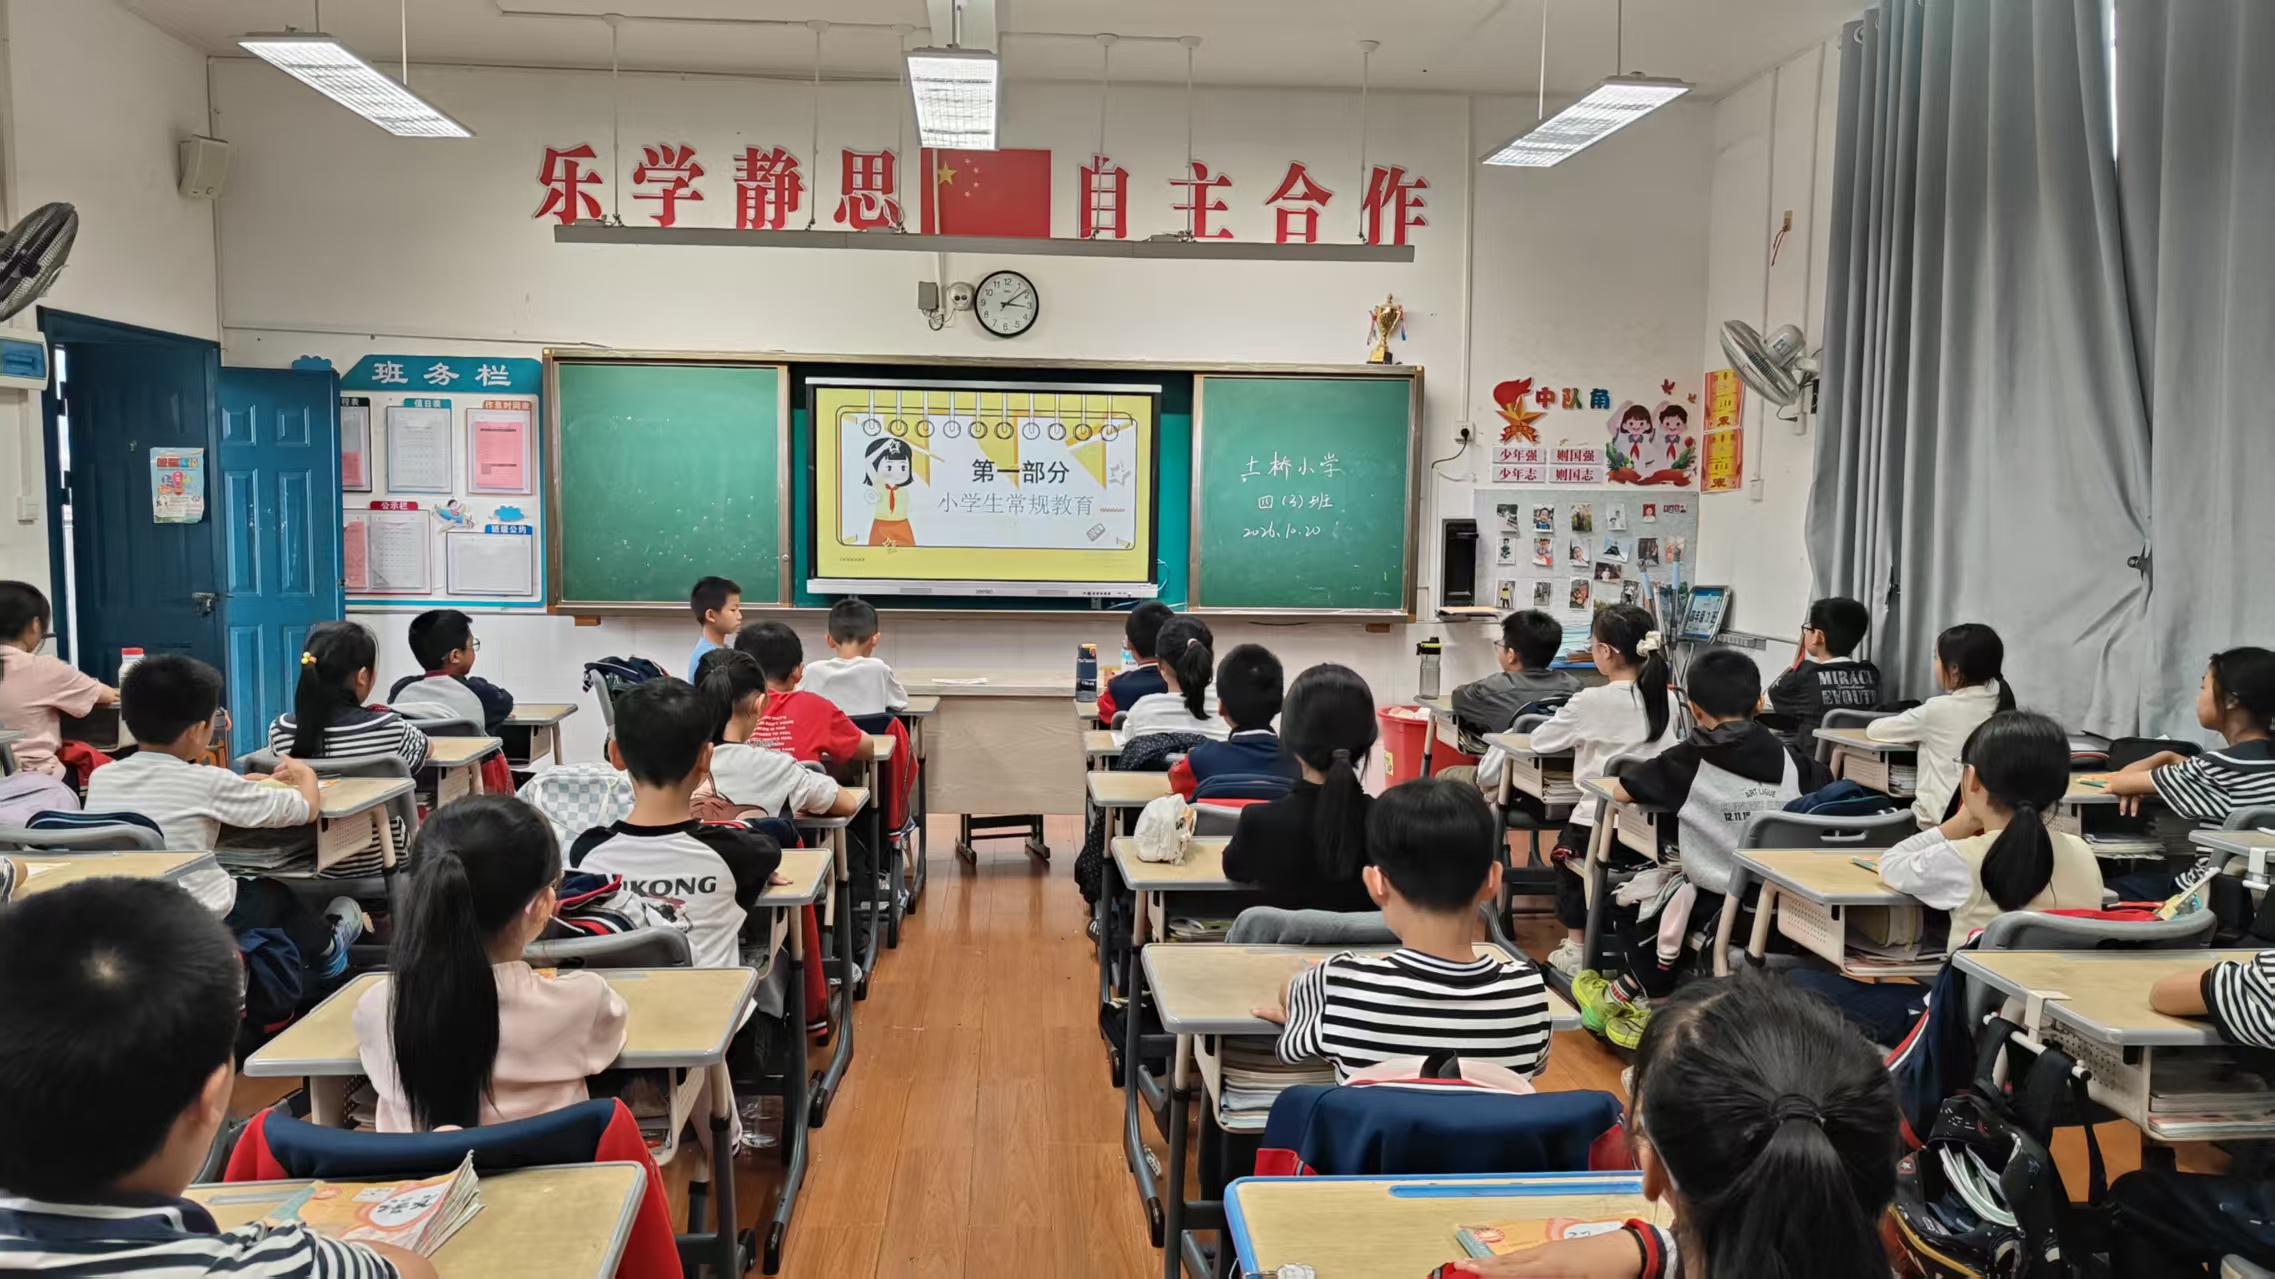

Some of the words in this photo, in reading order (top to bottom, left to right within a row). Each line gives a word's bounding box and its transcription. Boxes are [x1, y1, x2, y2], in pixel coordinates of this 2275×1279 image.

[533, 144, 904, 230] 乐学静思
[1079, 155, 1430, 247] 自主合作
[372, 361, 512, 387] 班务栏
[1536, 387, 1610, 409] 中队角
[1241, 451, 1341, 482] 土桥小学
[1500, 449, 1537, 462] 少年强
[1557, 449, 1595, 462] 则国强
[972, 459, 1070, 484] 第一部分
[1499, 468, 1537, 481] 少年志
[1556, 468, 1594, 481] 则国志
[938, 492, 1094, 516] 小学生常规教育
